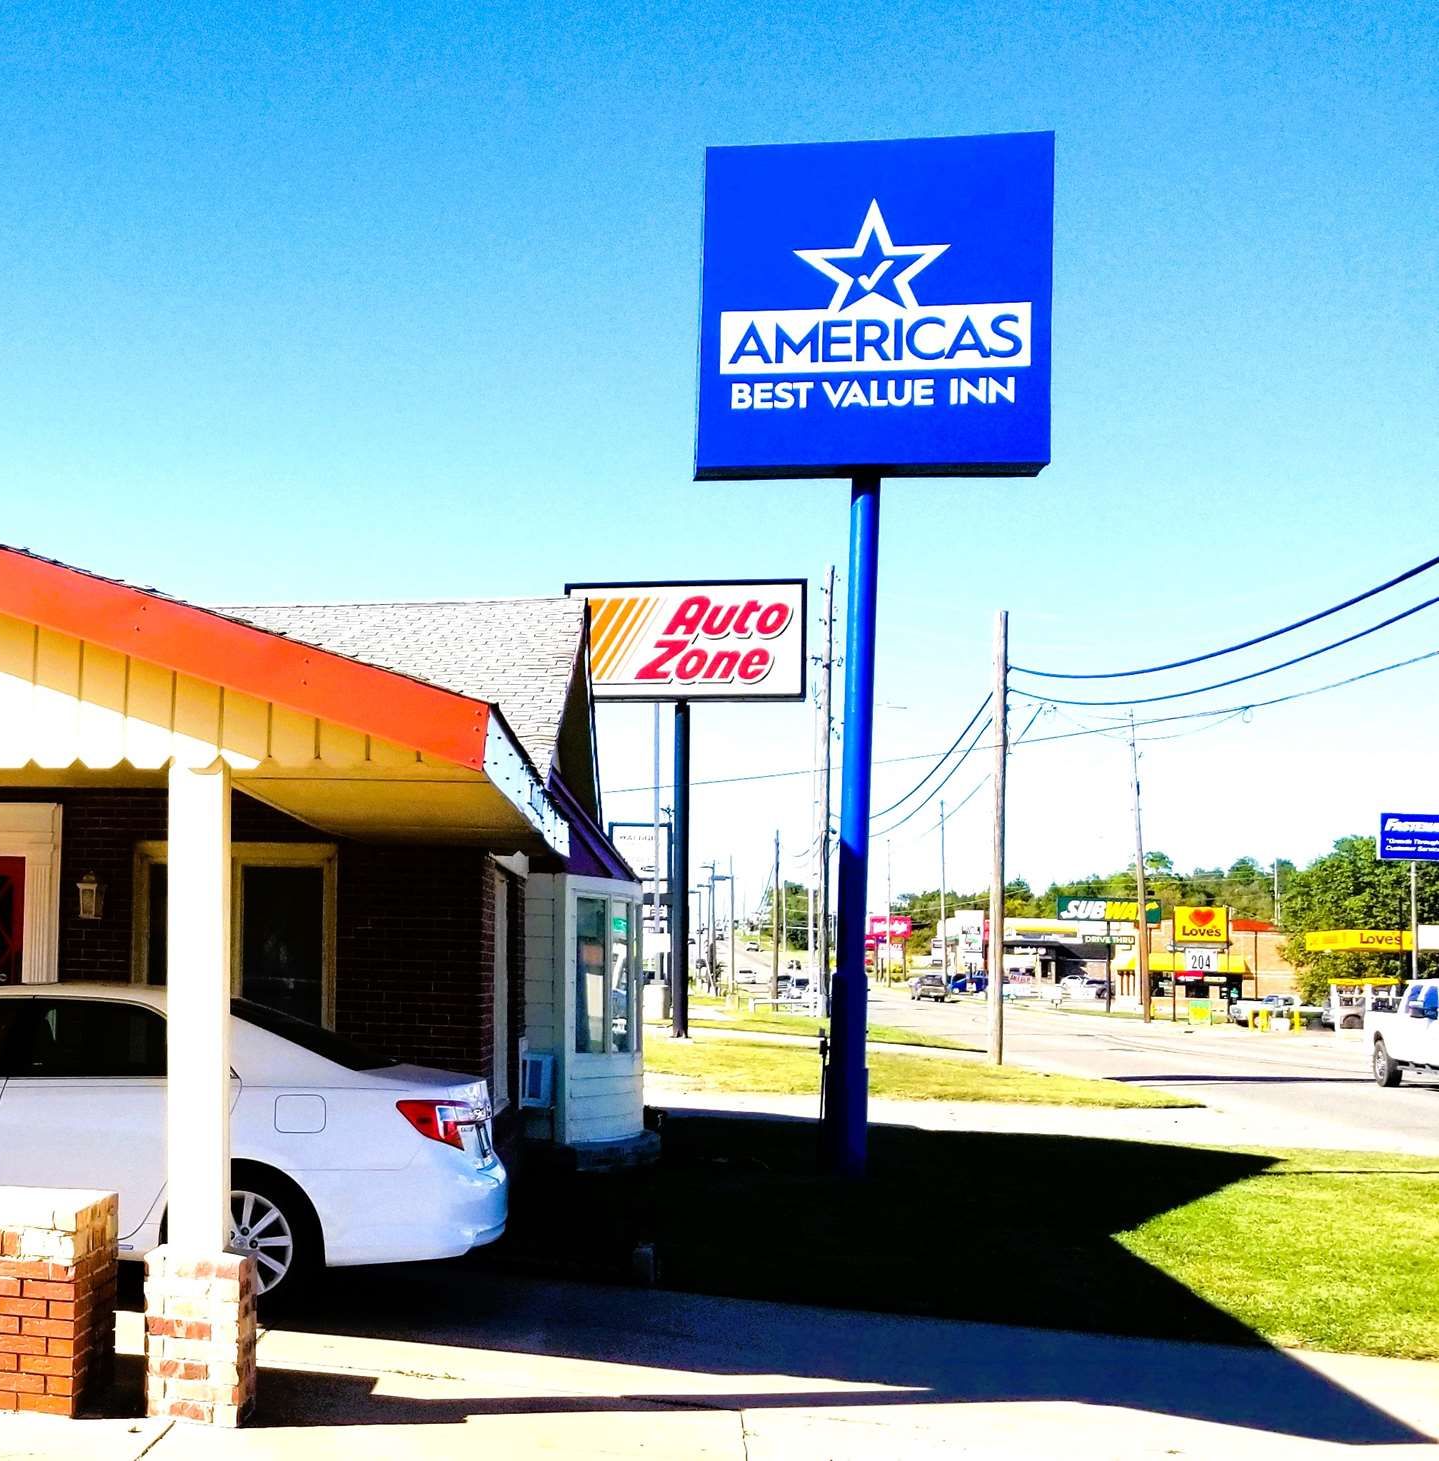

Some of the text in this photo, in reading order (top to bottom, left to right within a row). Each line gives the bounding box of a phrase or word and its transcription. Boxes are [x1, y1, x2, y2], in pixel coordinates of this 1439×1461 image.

[728, 314, 1023, 365] AMERICAS
[731, 376, 1016, 410] BEST VALUE INN
[662, 595, 792, 636] Auto
[634, 639, 771, 681] Zone
[1085, 936, 1134, 944] DRIVE THRU
[1182, 925, 1221, 937] Love's
[1191, 955, 1211, 969] 204
